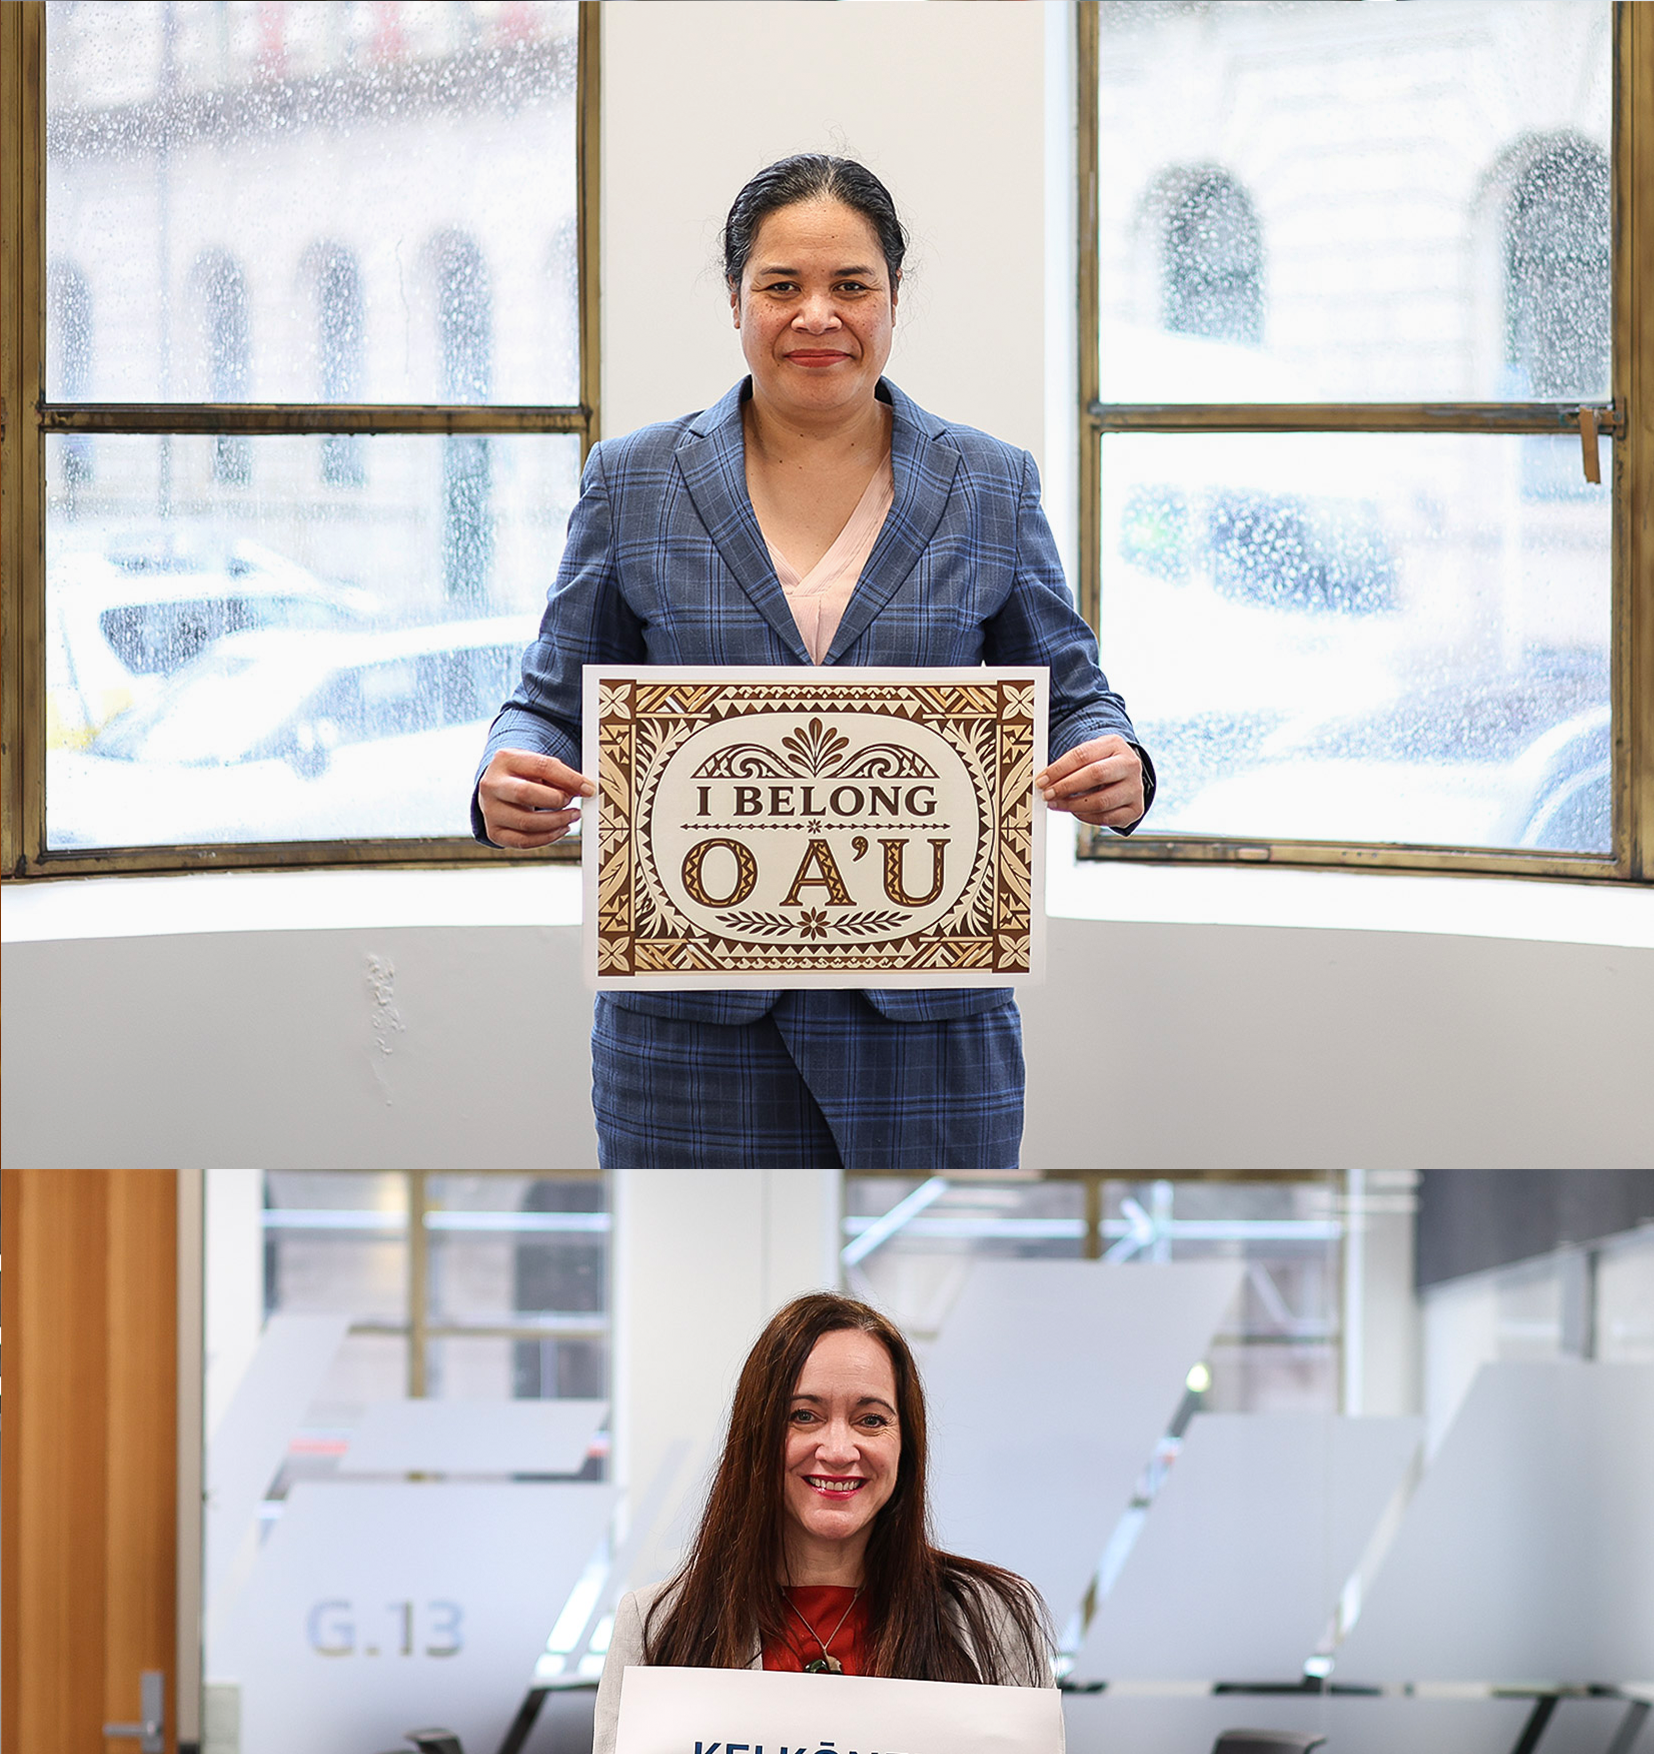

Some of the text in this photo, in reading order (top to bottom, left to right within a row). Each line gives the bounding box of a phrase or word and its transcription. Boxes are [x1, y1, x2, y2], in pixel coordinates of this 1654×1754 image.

[696, 785, 938, 817] I BELONG
[681, 837, 758, 908] O
[306, 1598, 466, 1659] G.13
